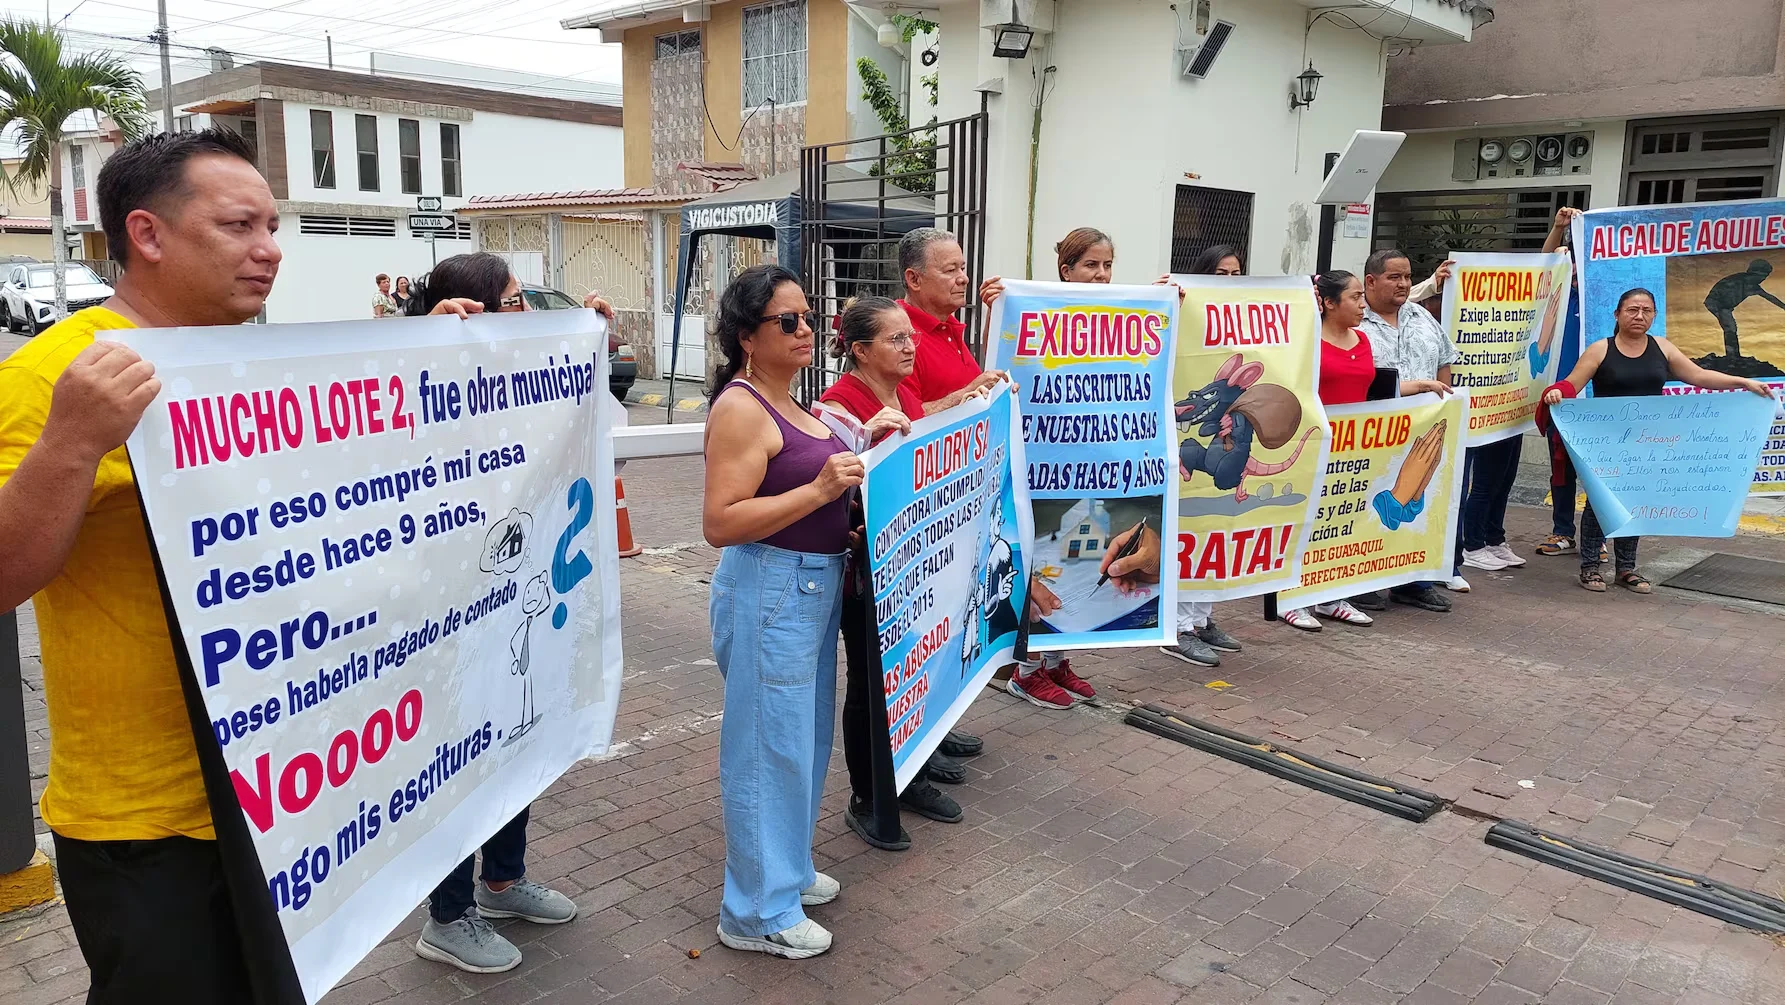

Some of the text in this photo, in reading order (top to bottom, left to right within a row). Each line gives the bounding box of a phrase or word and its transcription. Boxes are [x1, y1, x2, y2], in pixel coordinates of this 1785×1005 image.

[413, 218, 429, 226] UNA
[689, 202, 778, 229] VIGICUSTODIA
[1592, 222, 1692, 259] ALCALDE
[1462, 271, 1533, 302] VICTORIA
[1205, 304, 1290, 347] DALDRY
[1459, 308, 1490, 326] Exige
[1492, 307, 1501, 322] la
[1016, 312, 1161, 357] EXIGIMOS
[1456, 328, 1514, 344] Inmediata
[1453, 349, 1512, 366] Escrituras
[1030, 373, 1151, 404] LAS ESCRITURAS
[168, 351, 597, 469] MUCHO LOTE 2, fue obra municipal
[1560, 403, 1615, 424] Señores
[1619, 402, 1661, 422] Banco
[1668, 405, 1684, 420] del
[1035, 413, 1119, 443] NUESTRAS
[1122, 412, 1157, 441] CASAS
[1361, 414, 1411, 449] CLUB
[1636, 428, 1681, 448] Embargo
[1686, 426, 1729, 443] Nosotros
[1739, 427, 1757, 443] No
[914, 425, 972, 492] DALDRY
[1074, 460, 1120, 491] HACE
[1122, 460, 1133, 494] 9
[1135, 452, 1165, 487] AÑOS
[1598, 450, 1612, 463] Que
[190, 440, 526, 557] por eso compré mi casa
[1331, 480, 1346, 496] de
[1349, 477, 1369, 493] las
[1315, 497, 1367, 521] s y de la
[1309, 520, 1354, 542] ción al
[196, 498, 487, 609] desde hace 9 años,
[873, 566, 886, 595] TE
[925, 513, 954, 548] TODAS
[957, 502, 972, 528] LAS
[1178, 524, 1293, 580] RATA!
[1312, 548, 1327, 564] DE
[1328, 538, 1384, 562] GUAYAQUIL
[1357, 550, 1426, 576] CONDICIONES
[905, 565, 920, 597] QUE
[923, 542, 954, 581] FALTAN
[913, 587, 934, 622] 2015
[212, 580, 517, 751] pese haberla pagado de contado
[903, 616, 949, 683] ABUSADO
[337, 799, 381, 868] mis
[389, 719, 493, 824] escrituras
